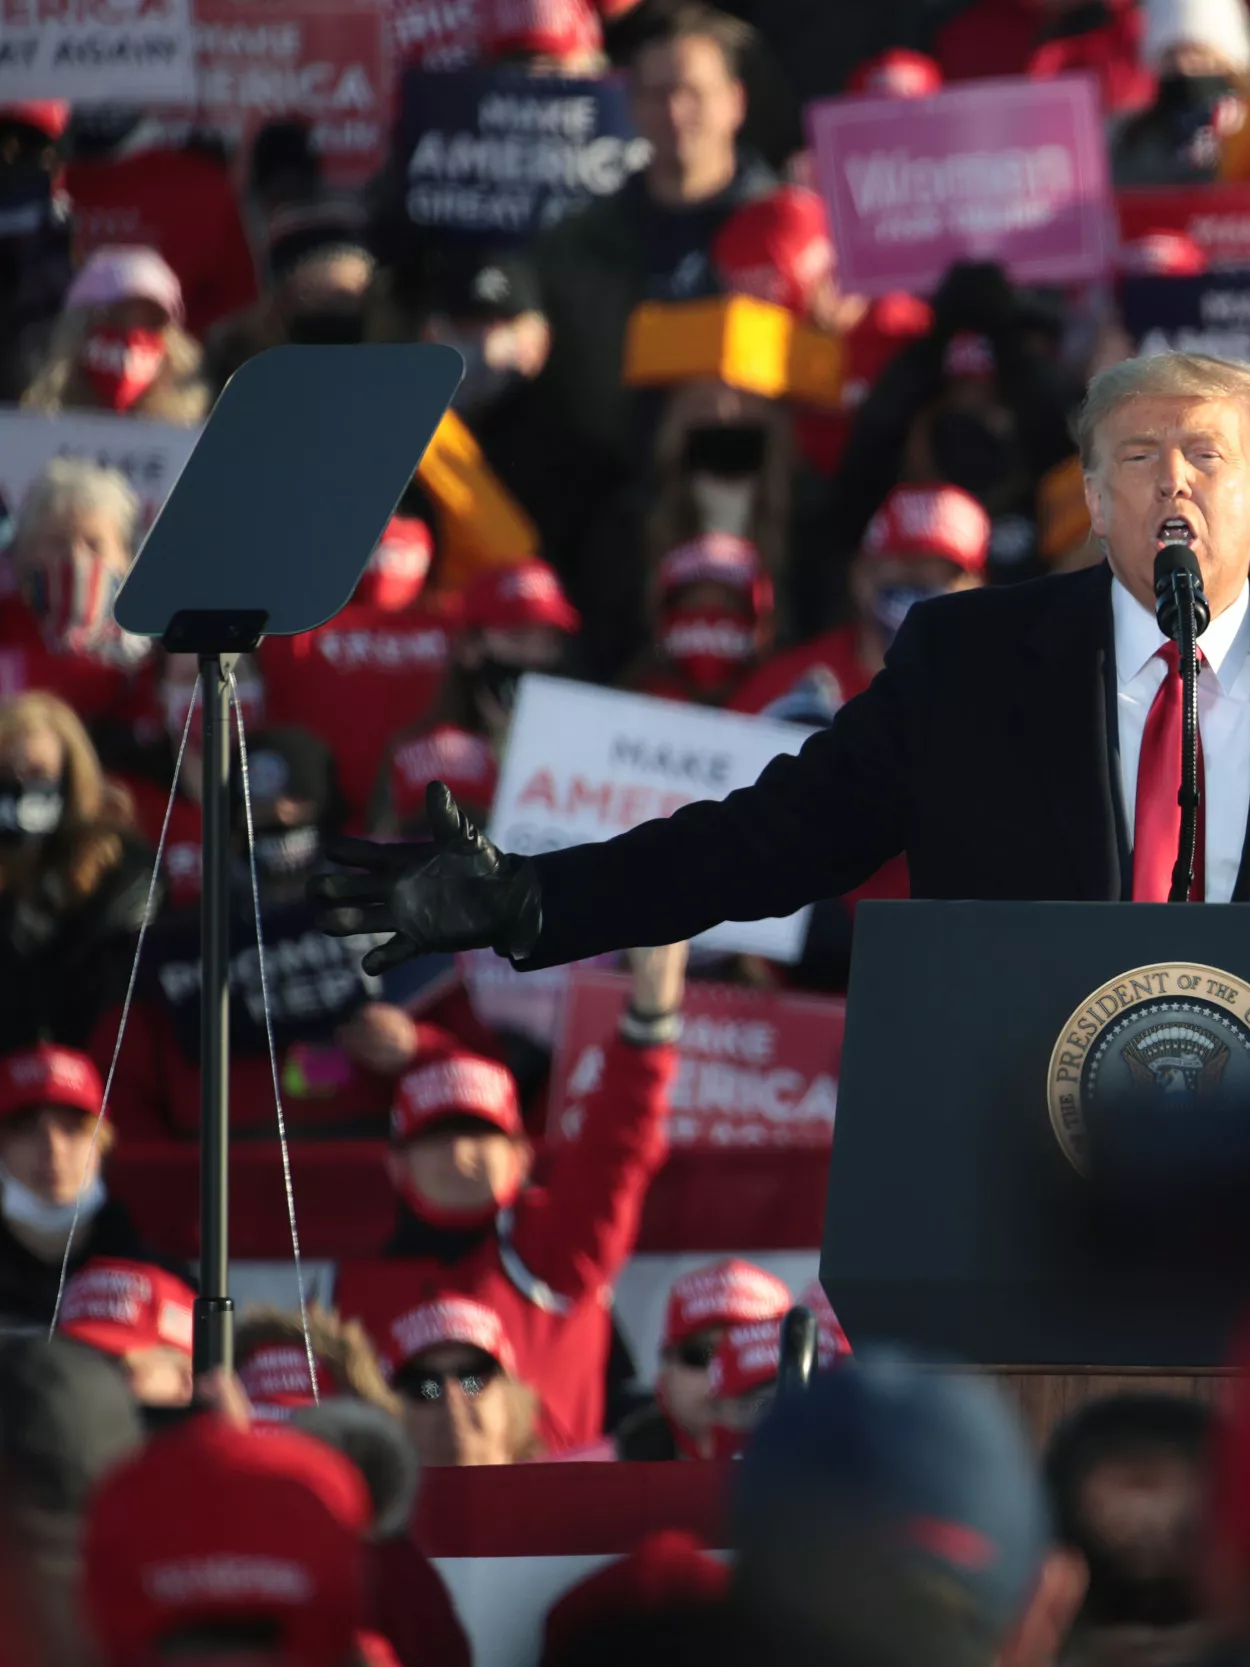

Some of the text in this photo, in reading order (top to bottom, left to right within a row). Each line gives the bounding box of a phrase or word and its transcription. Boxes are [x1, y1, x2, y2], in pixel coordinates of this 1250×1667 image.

[610, 731, 733, 785] MAKE
[1056, 971, 1169, 1084] PRESIDENT
[1177, 974, 1202, 991] OF
[1207, 979, 1239, 1005] THE
